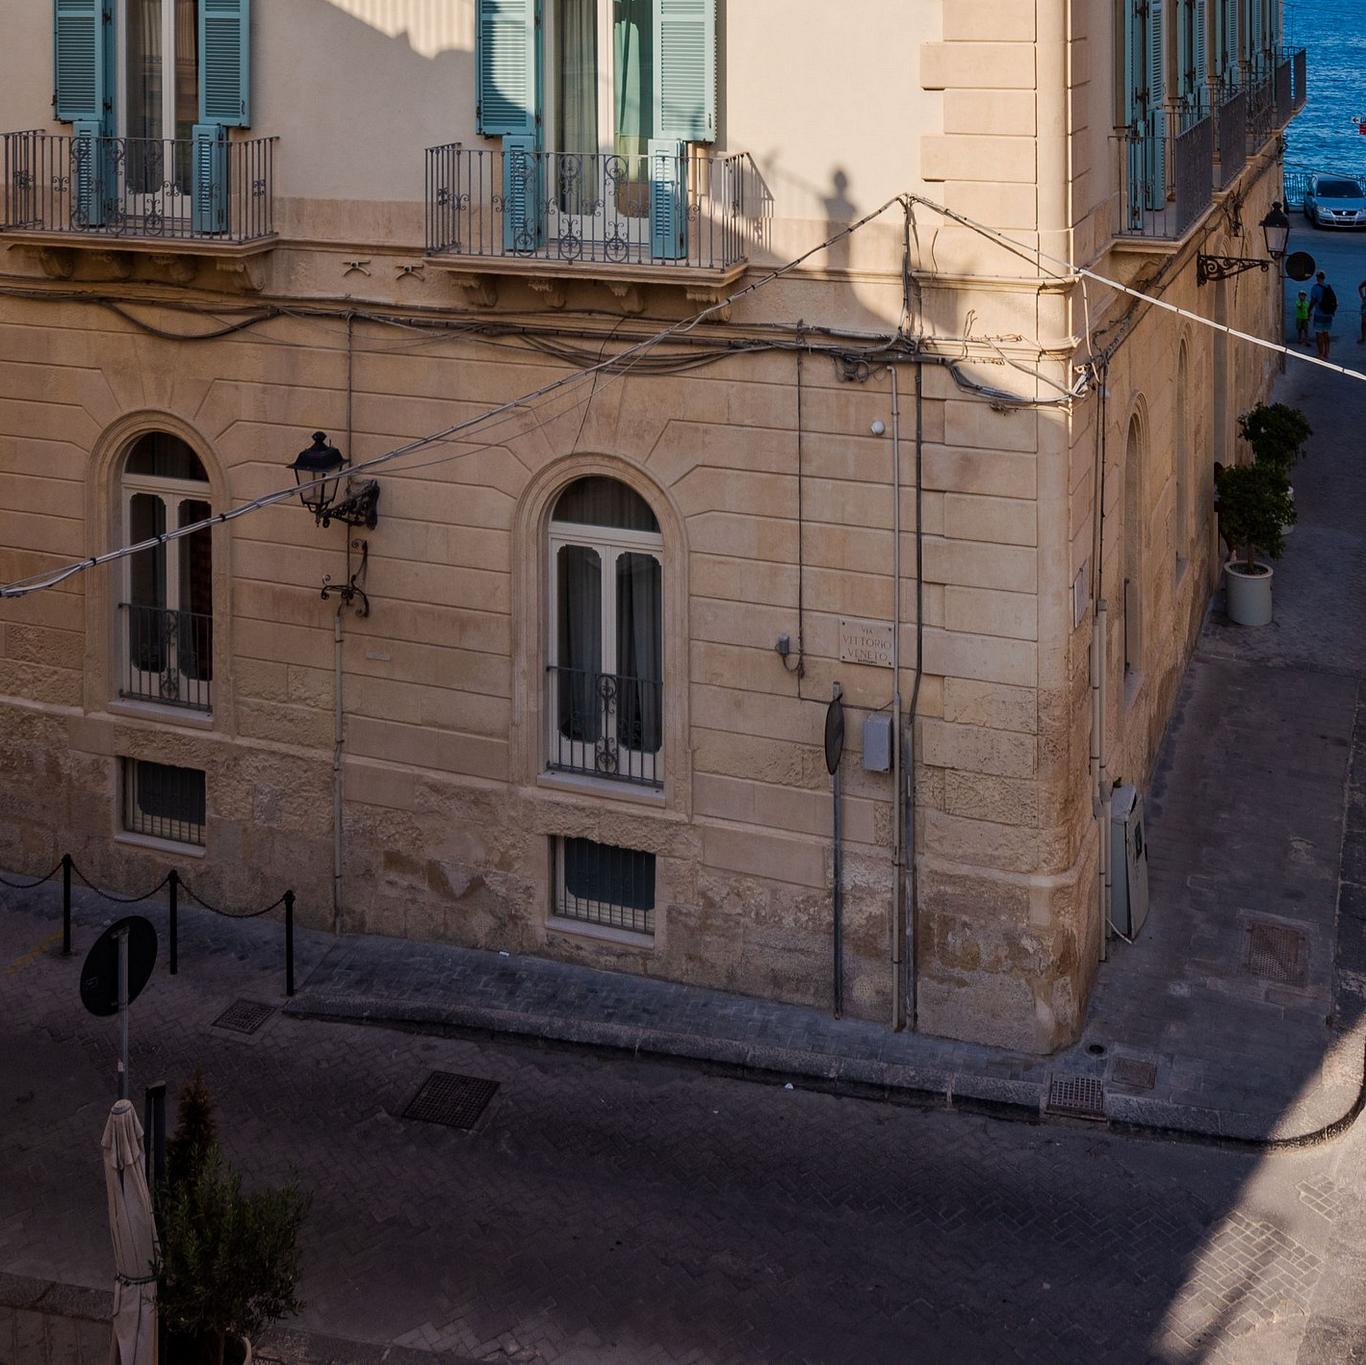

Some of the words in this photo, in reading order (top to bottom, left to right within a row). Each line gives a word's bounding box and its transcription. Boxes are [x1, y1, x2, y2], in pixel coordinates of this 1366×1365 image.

[861, 627, 873, 635] VIA
[842, 634, 892, 649] VITTORIO
[847, 648, 888, 661] VENETO
